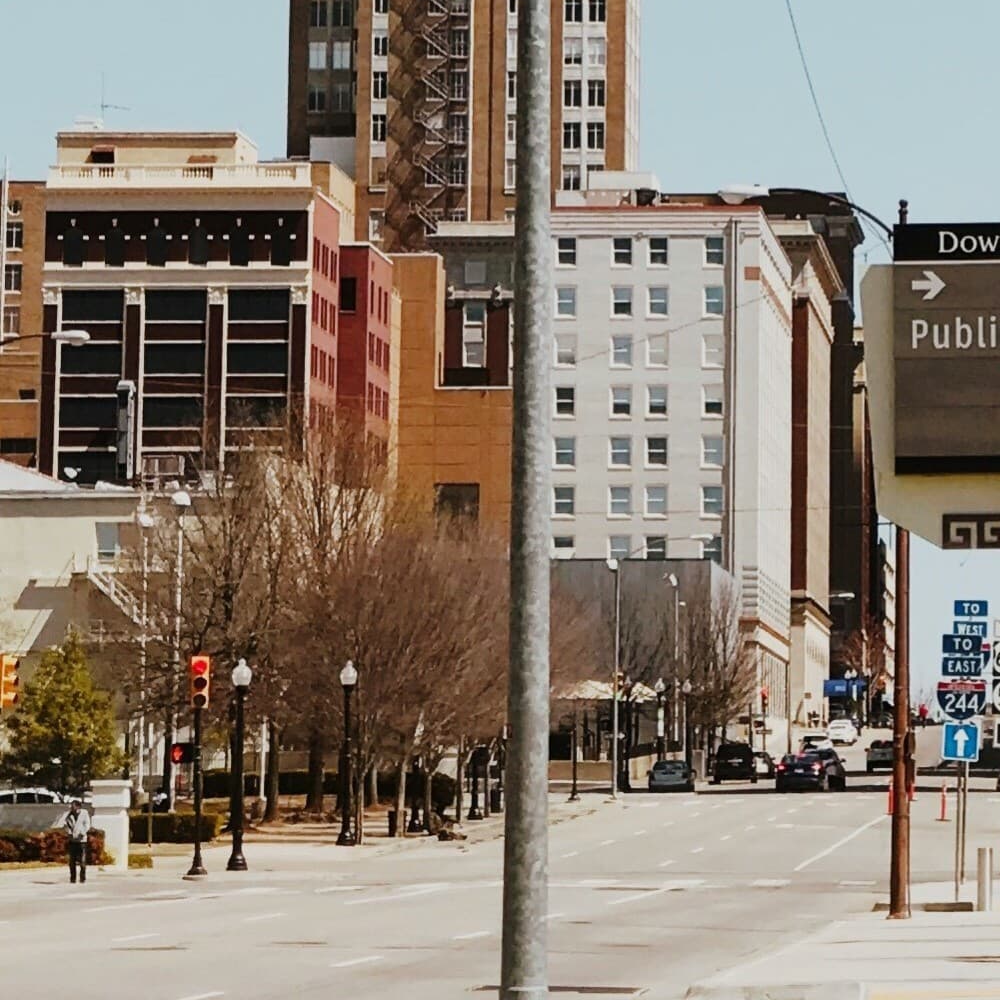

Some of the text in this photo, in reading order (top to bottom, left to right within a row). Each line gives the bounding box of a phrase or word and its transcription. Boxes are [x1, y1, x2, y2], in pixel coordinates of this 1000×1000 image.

[962, 603, 980, 614] TO
[957, 623, 984, 635] WEST
[952, 638, 973, 650] TO
[948, 660, 976, 673] EAST
[944, 694, 979, 713] 244
